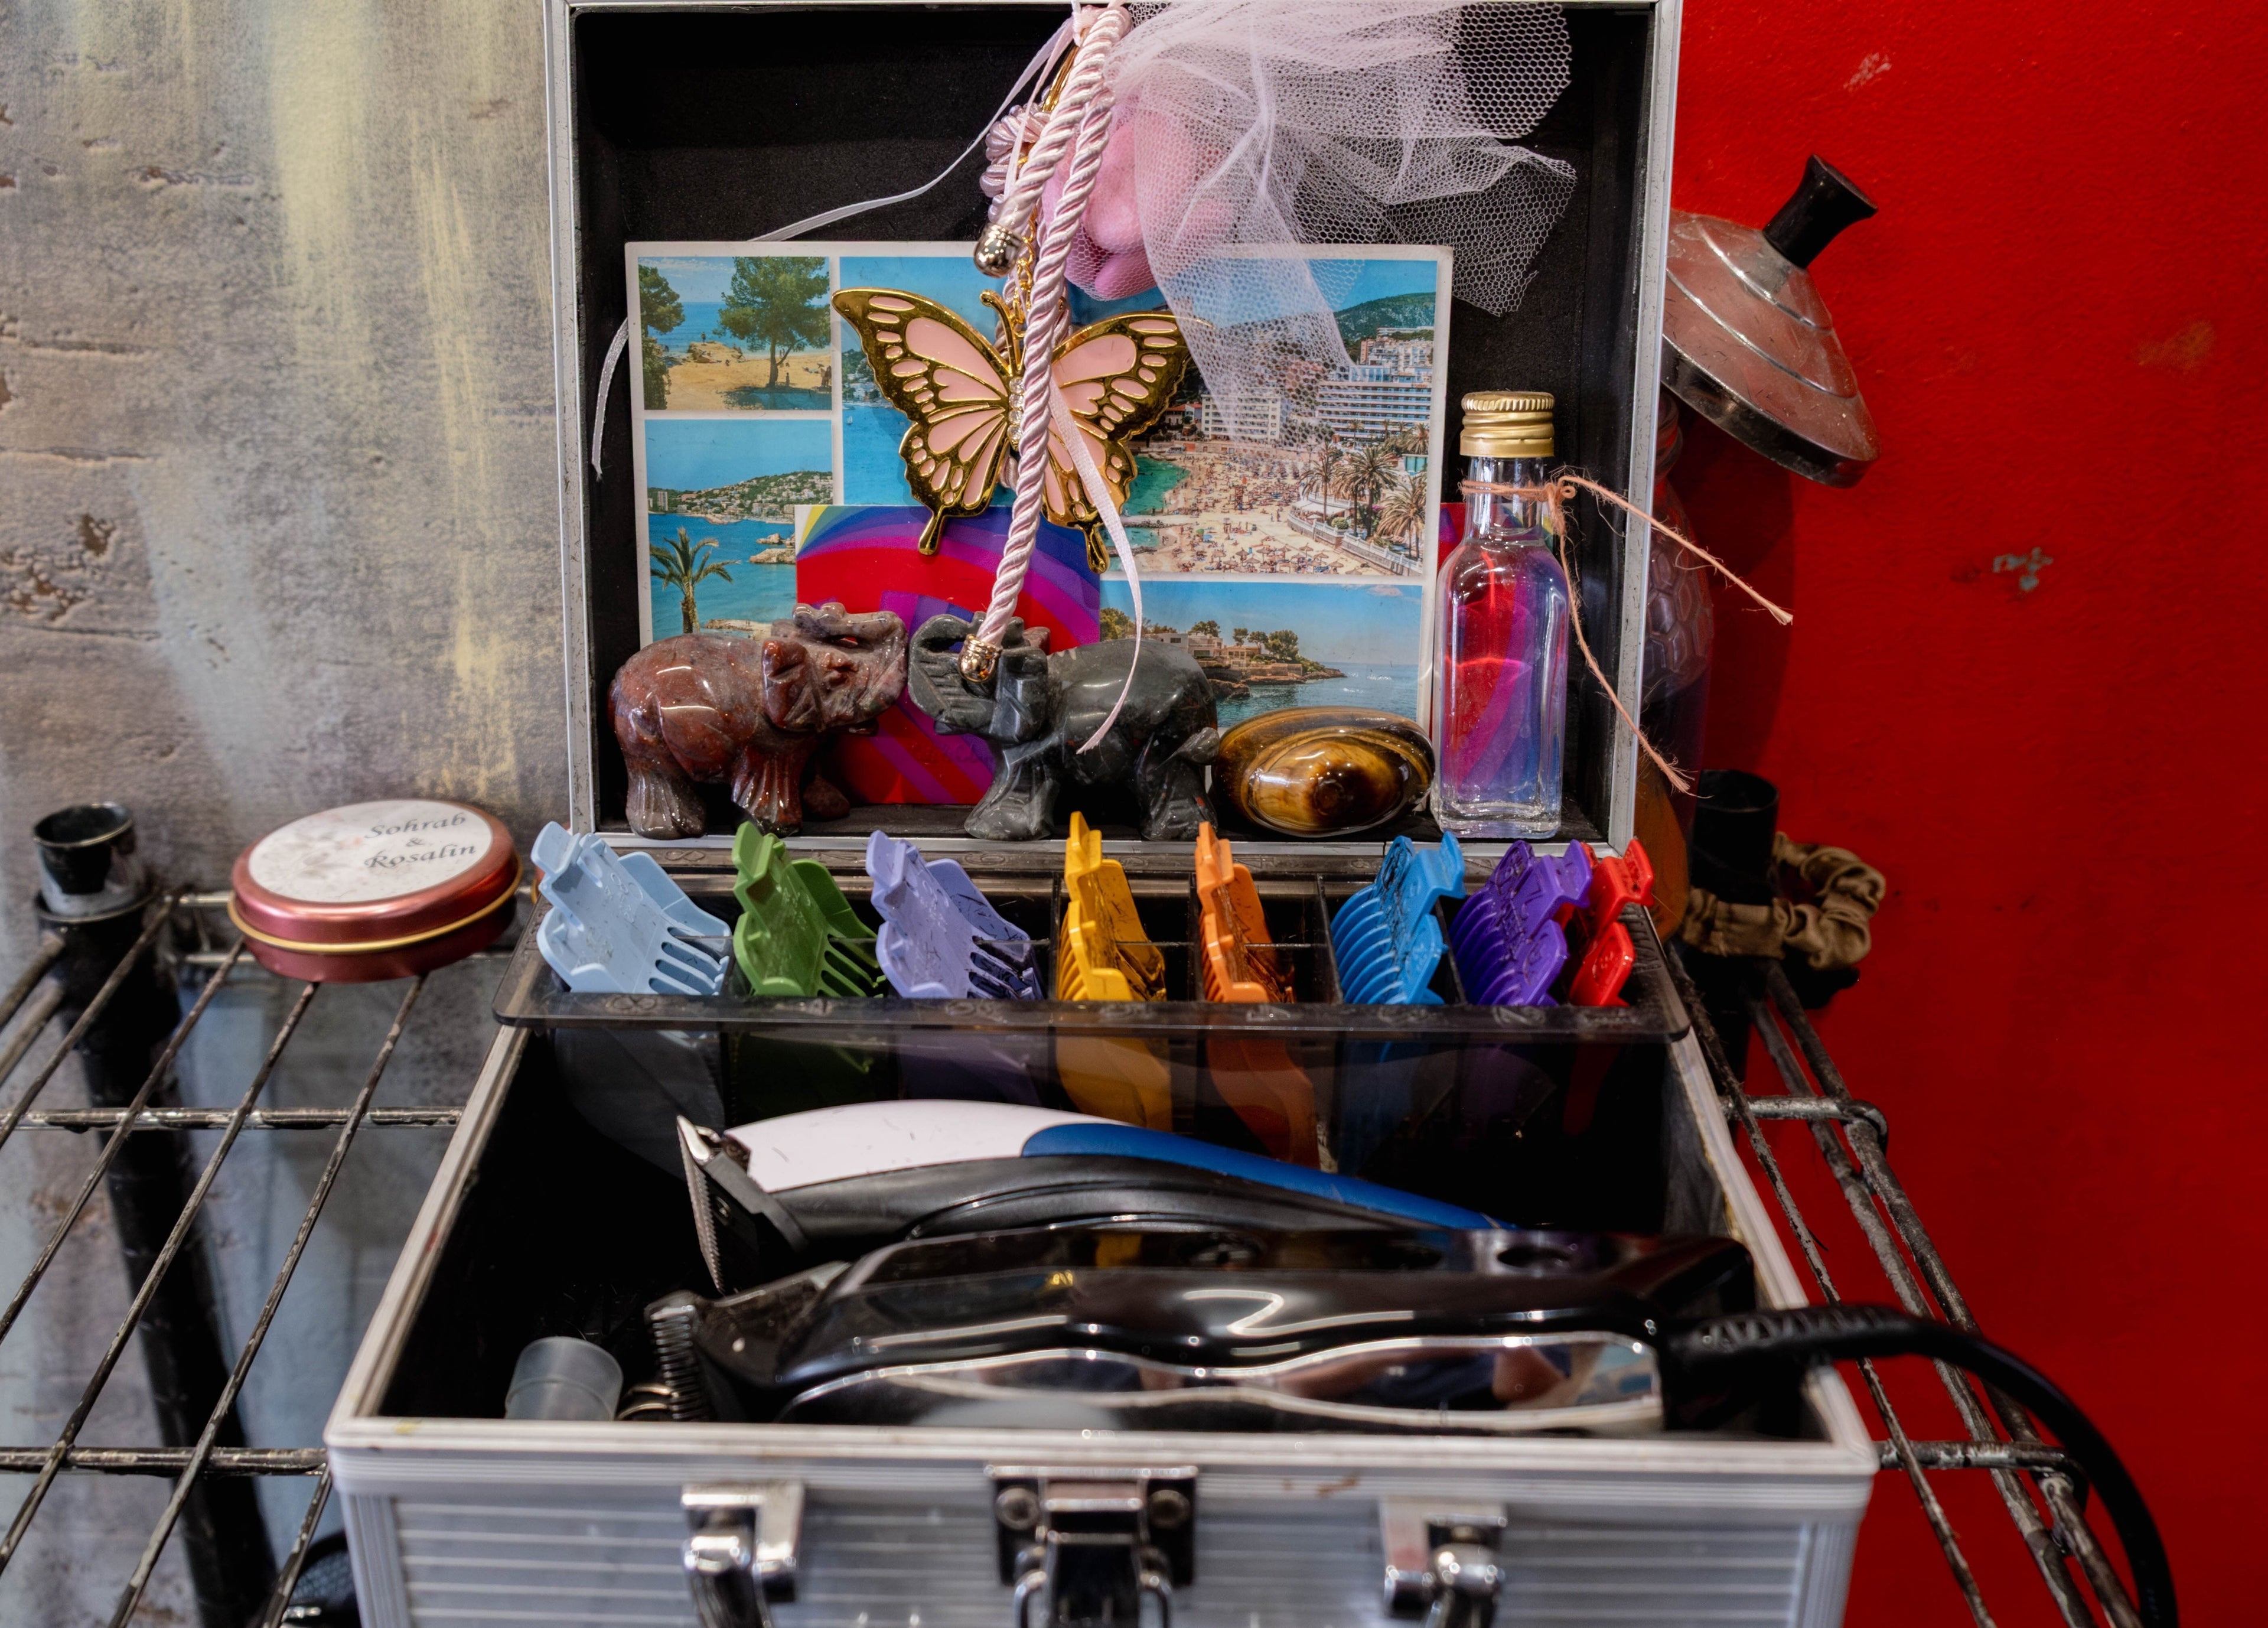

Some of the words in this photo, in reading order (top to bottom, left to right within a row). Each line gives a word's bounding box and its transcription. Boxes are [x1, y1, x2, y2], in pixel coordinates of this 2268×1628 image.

[364, 813, 465, 839] Sohrab
[406, 836, 424, 847] &
[364, 843, 476, 868] Rosalin
